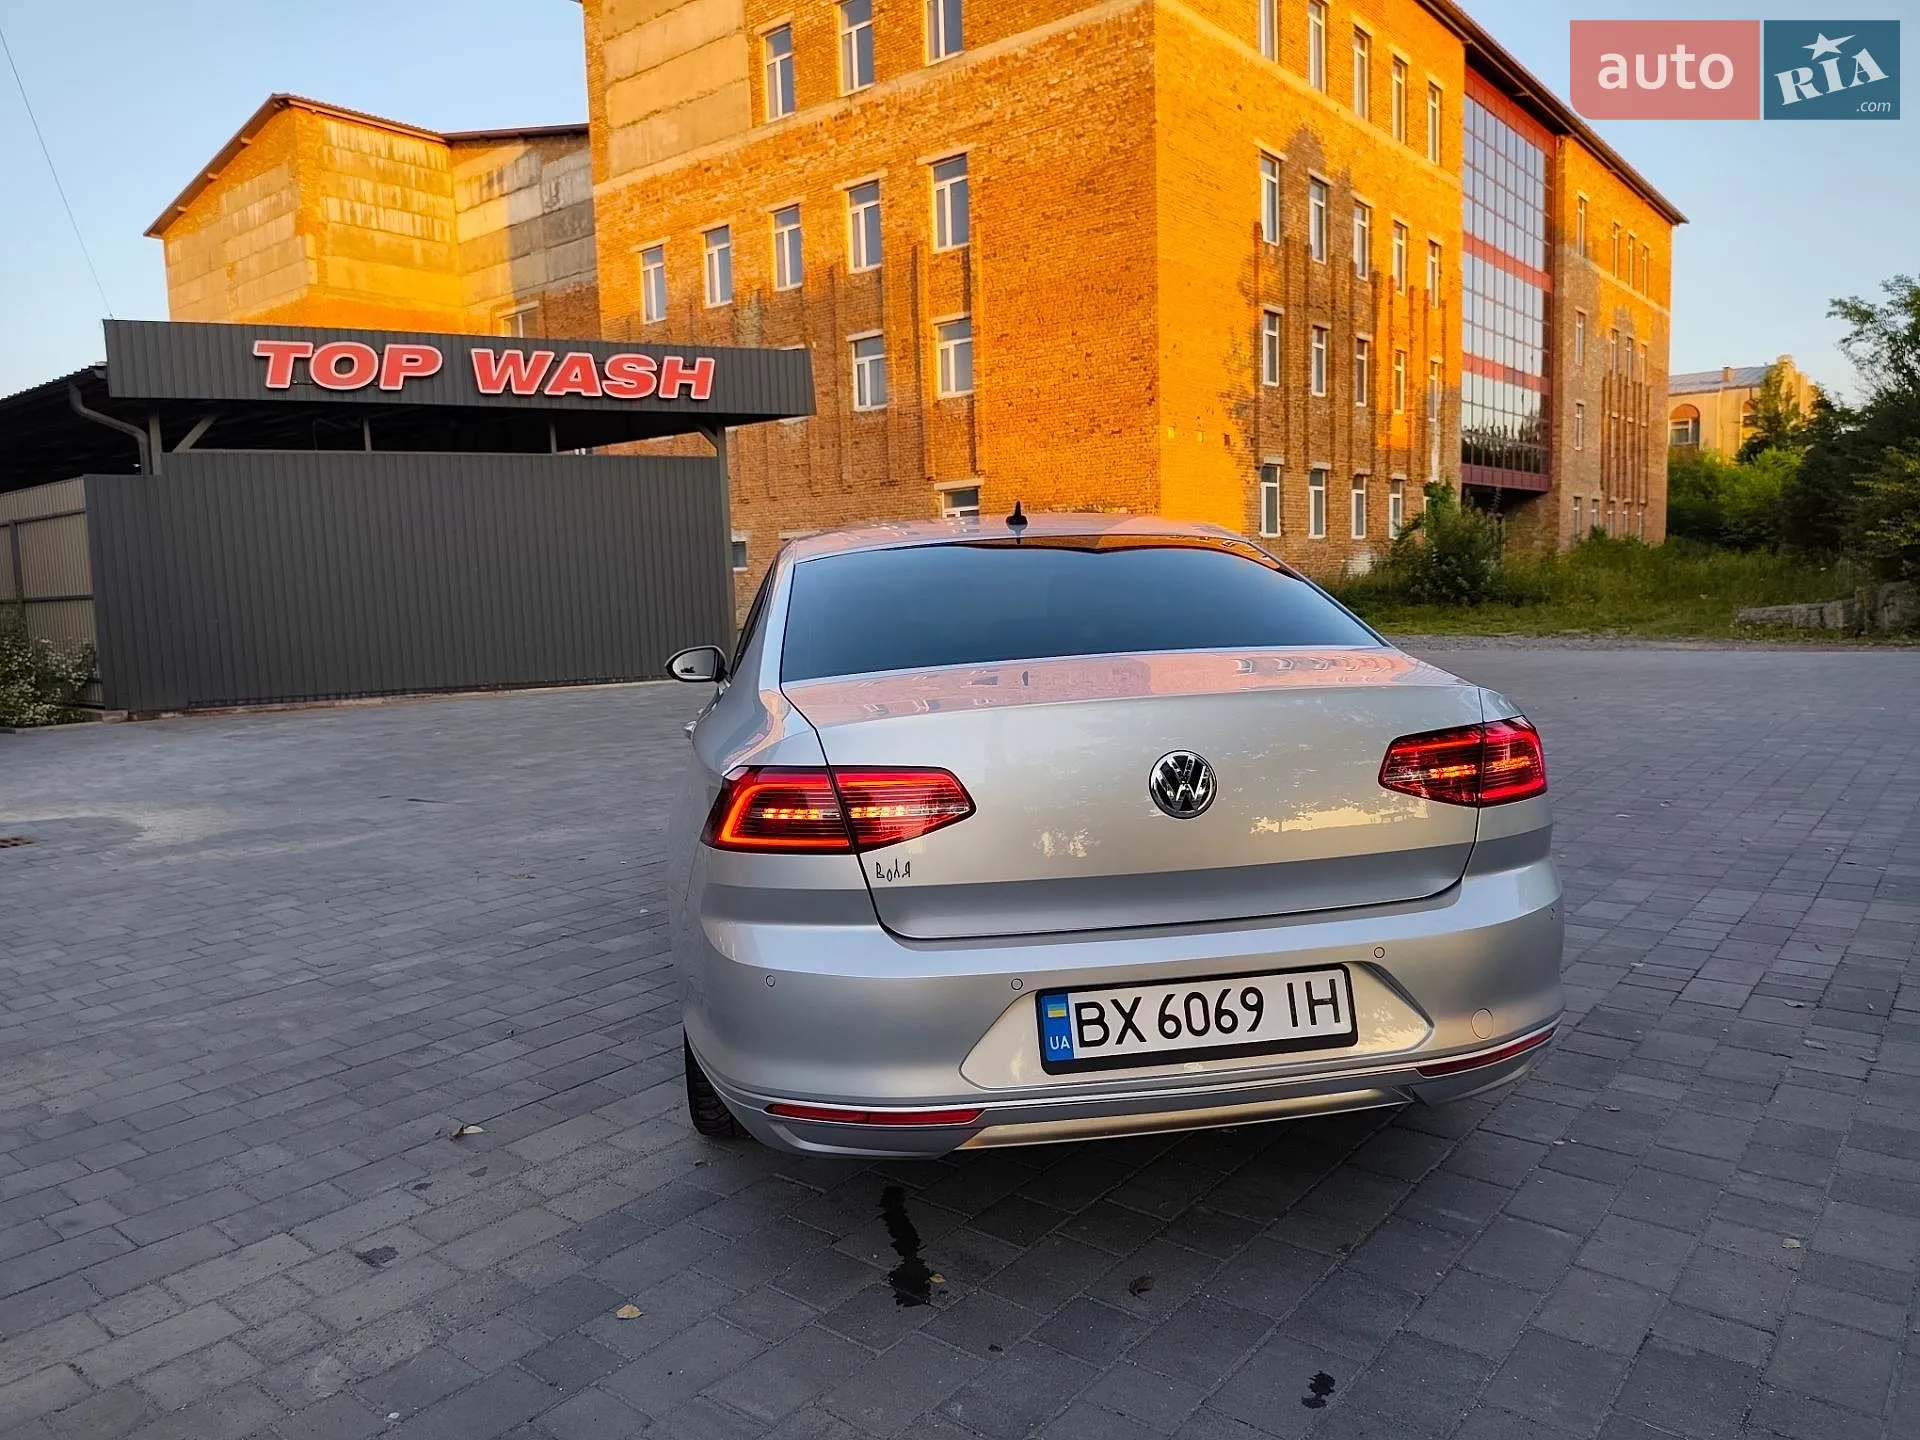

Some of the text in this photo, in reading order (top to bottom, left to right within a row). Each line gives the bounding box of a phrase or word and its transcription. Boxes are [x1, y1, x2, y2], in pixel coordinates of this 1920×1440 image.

[252, 339, 717, 401] TOP WASH
[1049, 1034, 1071, 1051] UA
[1074, 978, 1342, 1048] BX 6069 IH
